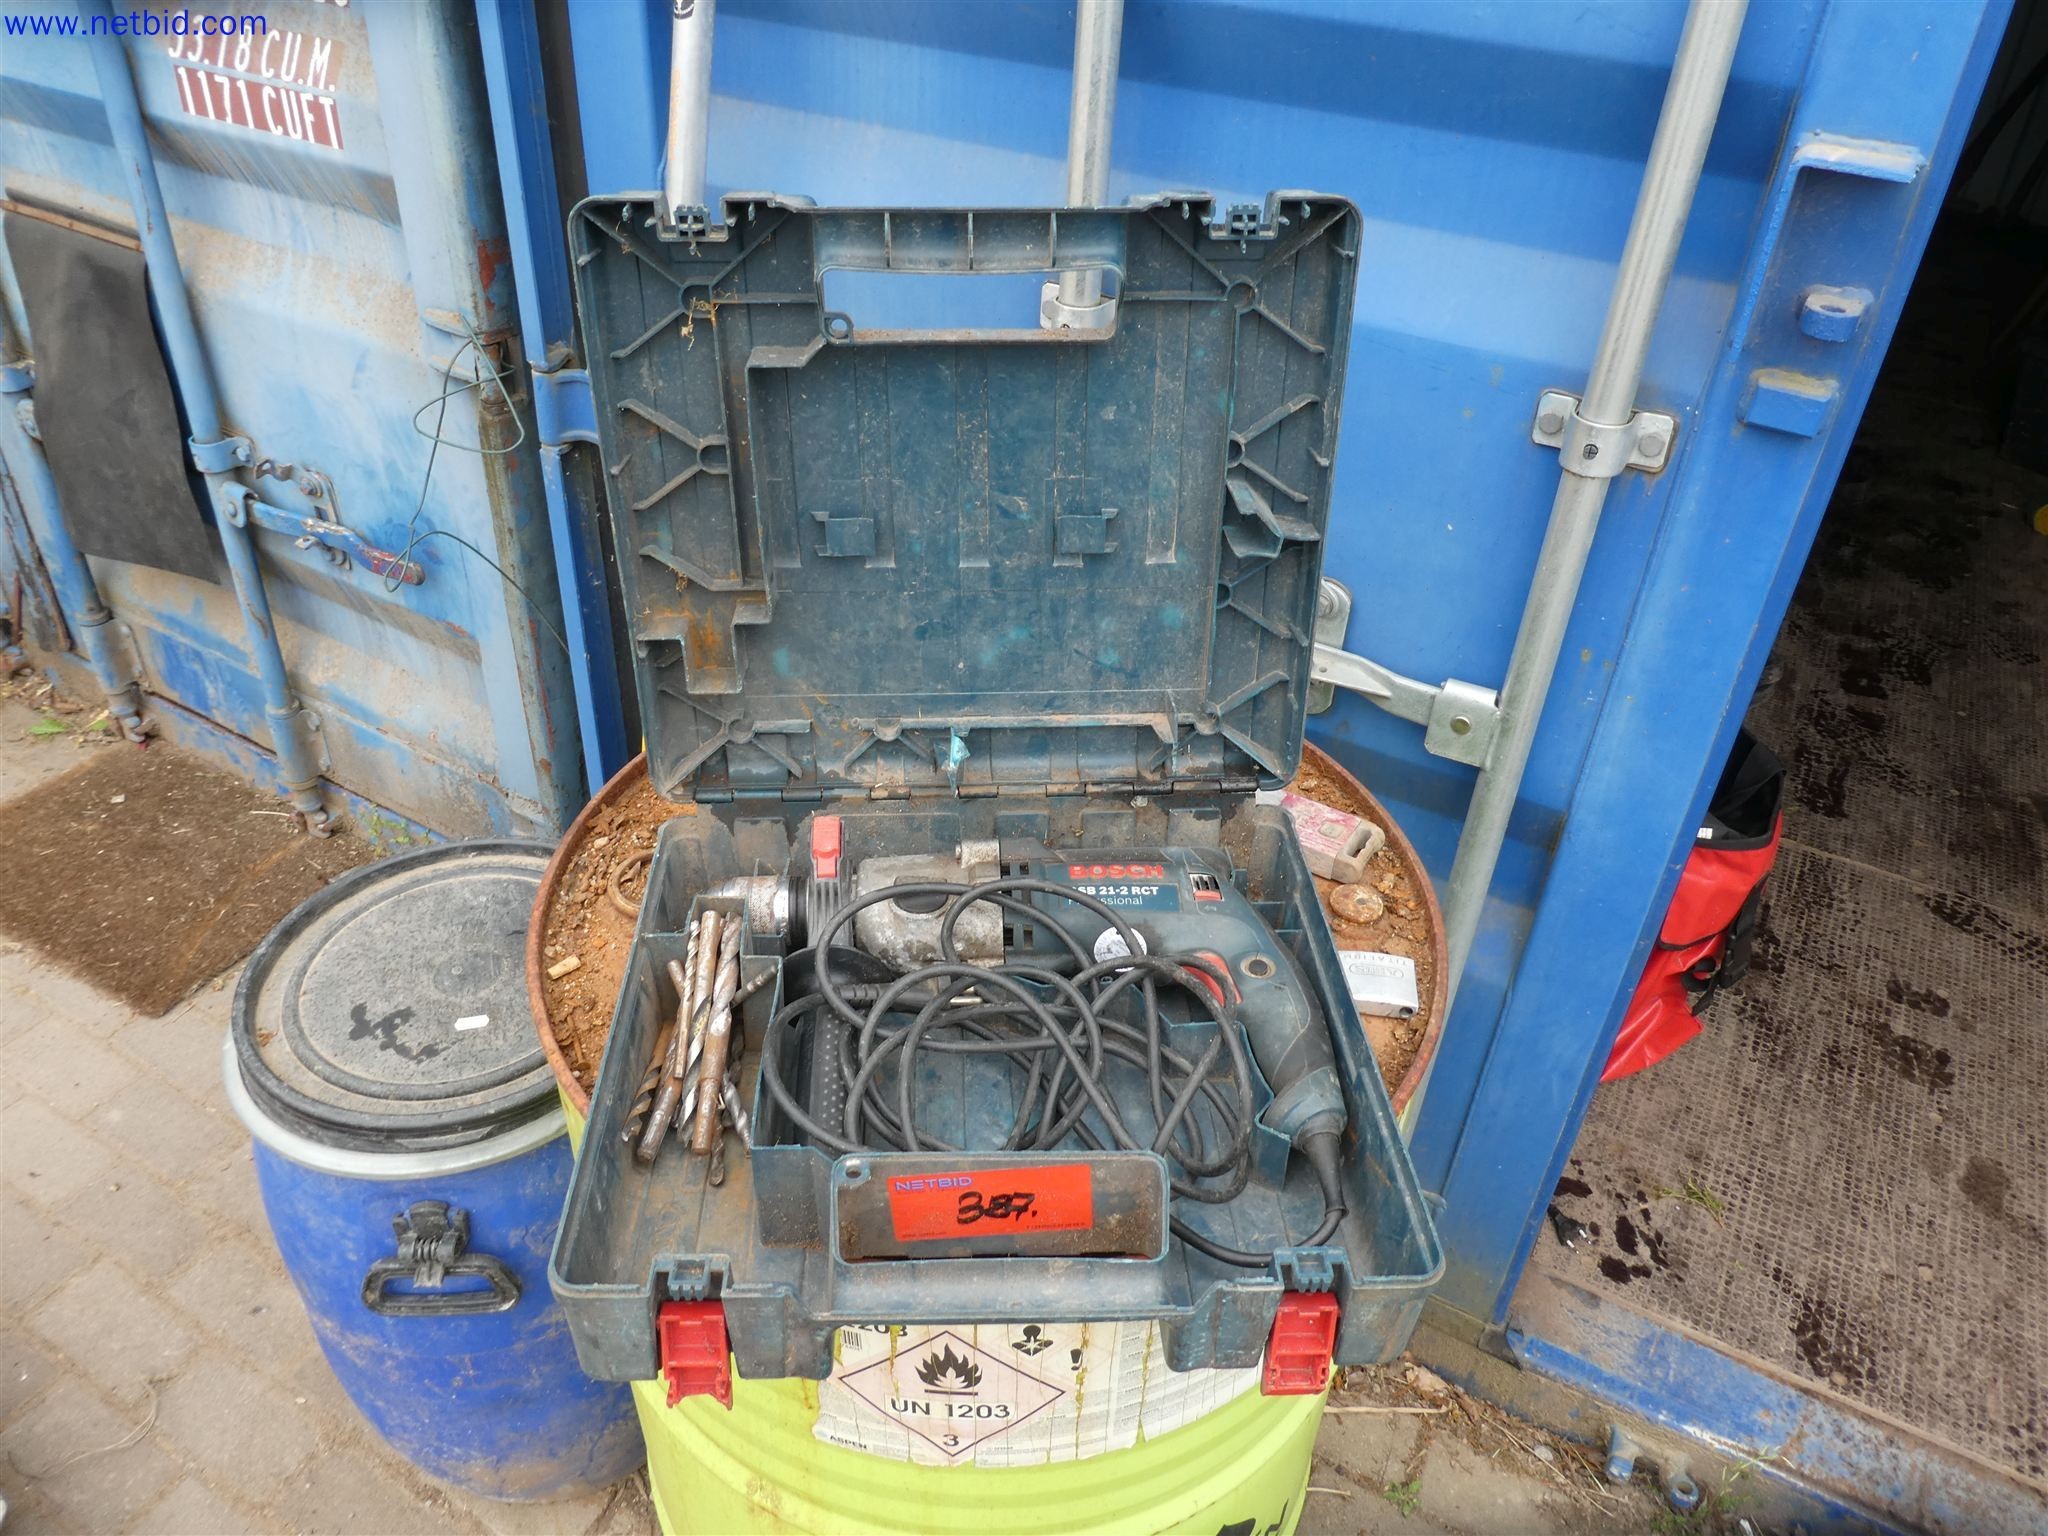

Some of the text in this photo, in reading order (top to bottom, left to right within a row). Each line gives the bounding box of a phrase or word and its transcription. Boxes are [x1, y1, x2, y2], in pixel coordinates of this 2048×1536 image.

[177, 66, 255, 129] 1171
[1068, 864, 1165, 880] BOSCH
[1071, 886, 1159, 896] SB 21-2 RCT
[894, 1176, 973, 1192] NETBID
[890, 1398, 1011, 1419] UN 1203
[943, 1433, 960, 1447] 3
